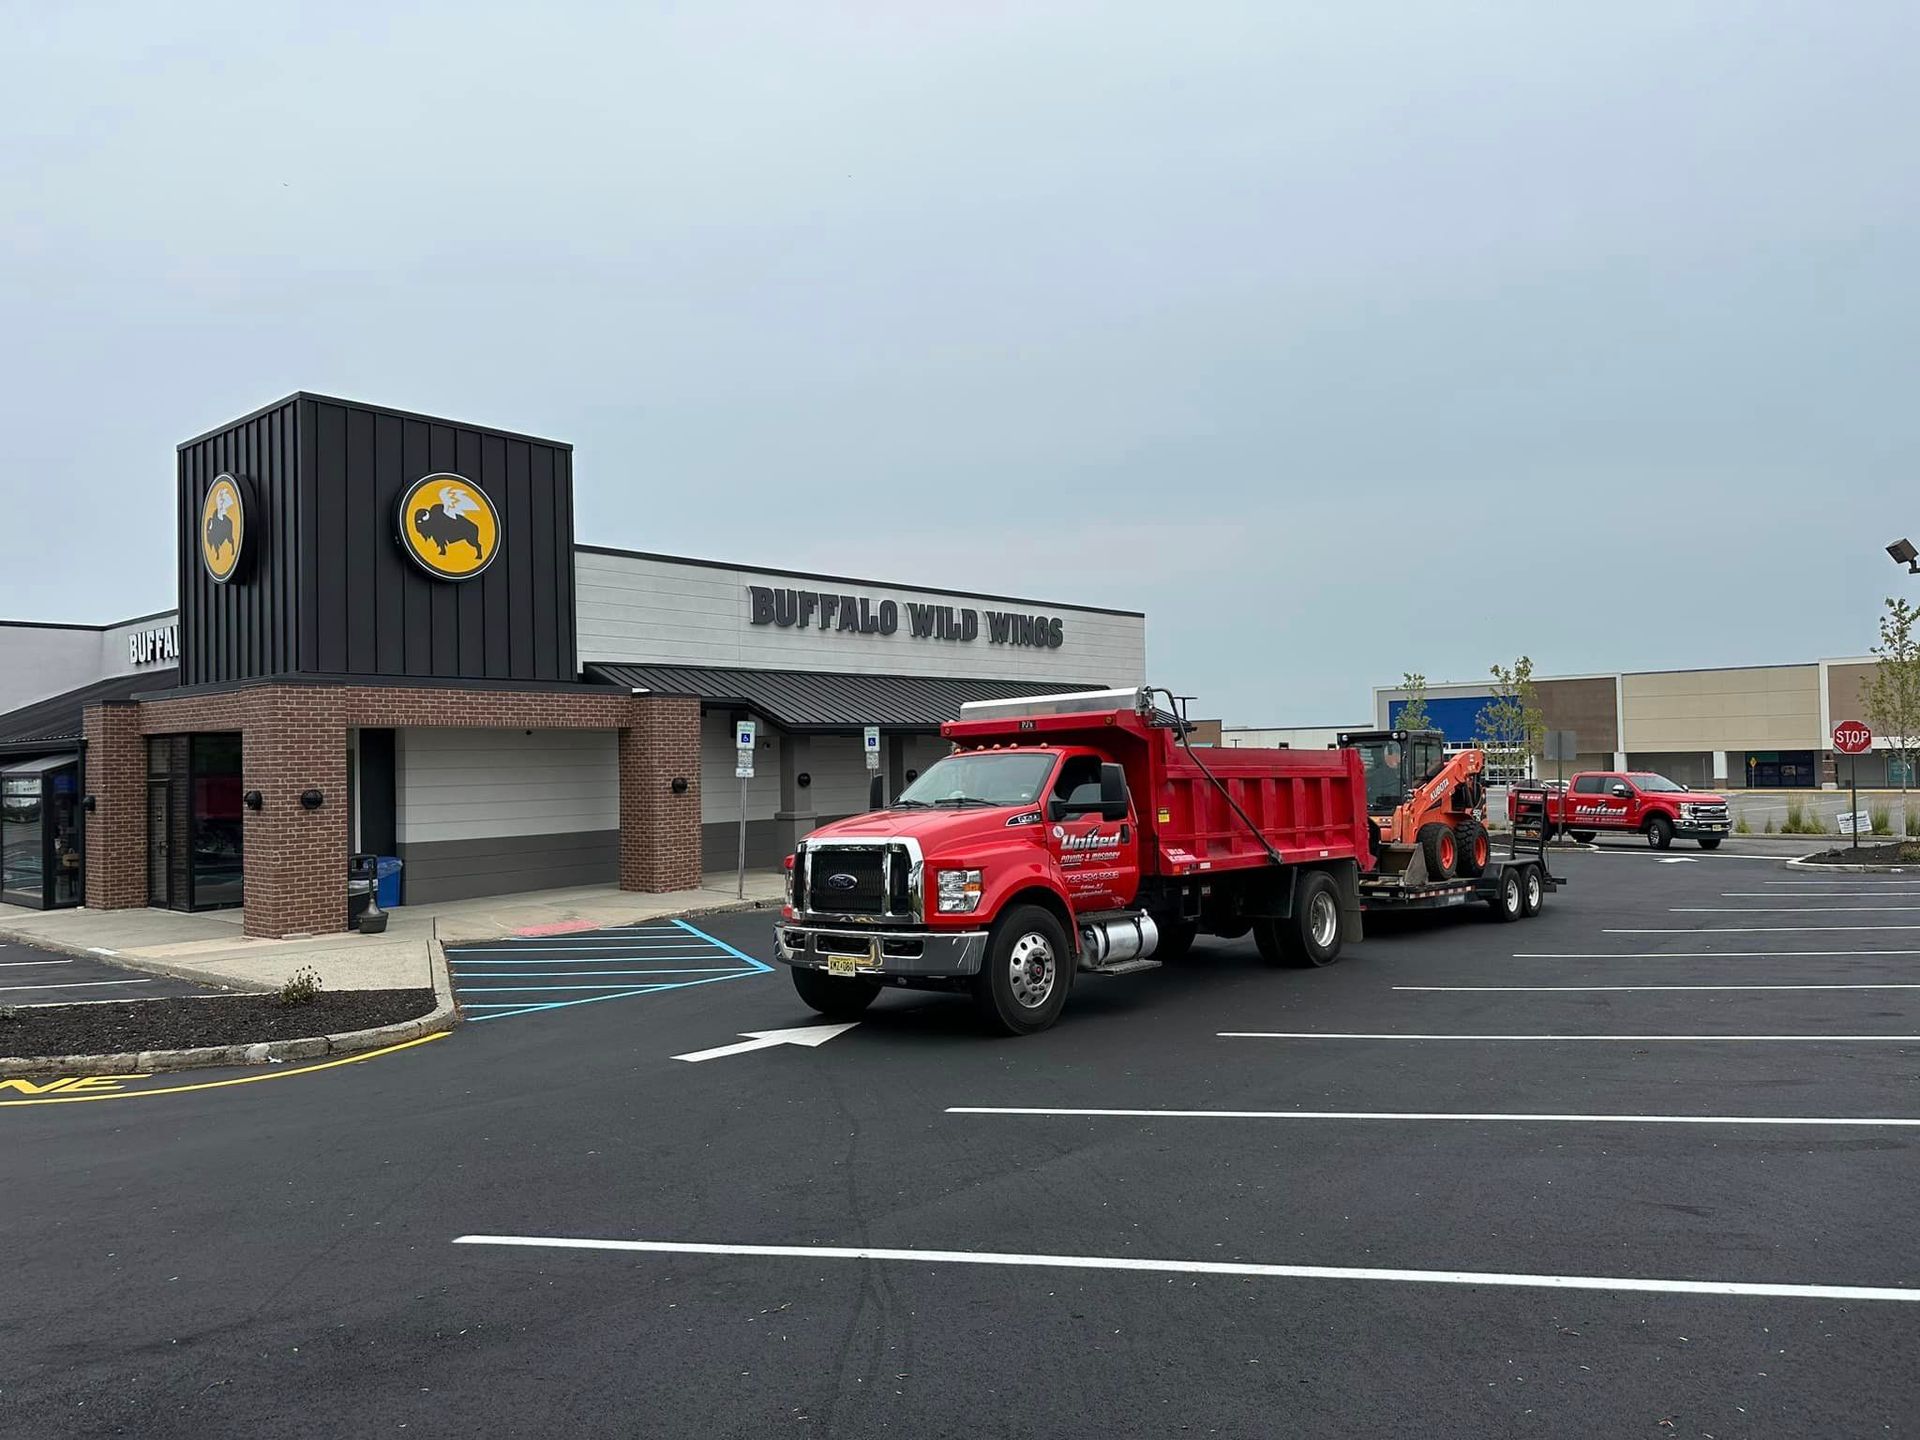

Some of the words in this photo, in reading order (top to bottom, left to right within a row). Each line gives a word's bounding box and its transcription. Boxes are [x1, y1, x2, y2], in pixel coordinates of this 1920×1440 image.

[748, 585, 898, 635] BUFFALO
[905, 602, 978, 641] WILD
[984, 610, 1064, 648] WINGS
[1836, 730, 1869, 743] STOP
[1430, 778, 1449, 801] KUBOTA
[1575, 805, 1628, 816] United
[1061, 832, 1120, 850] United
